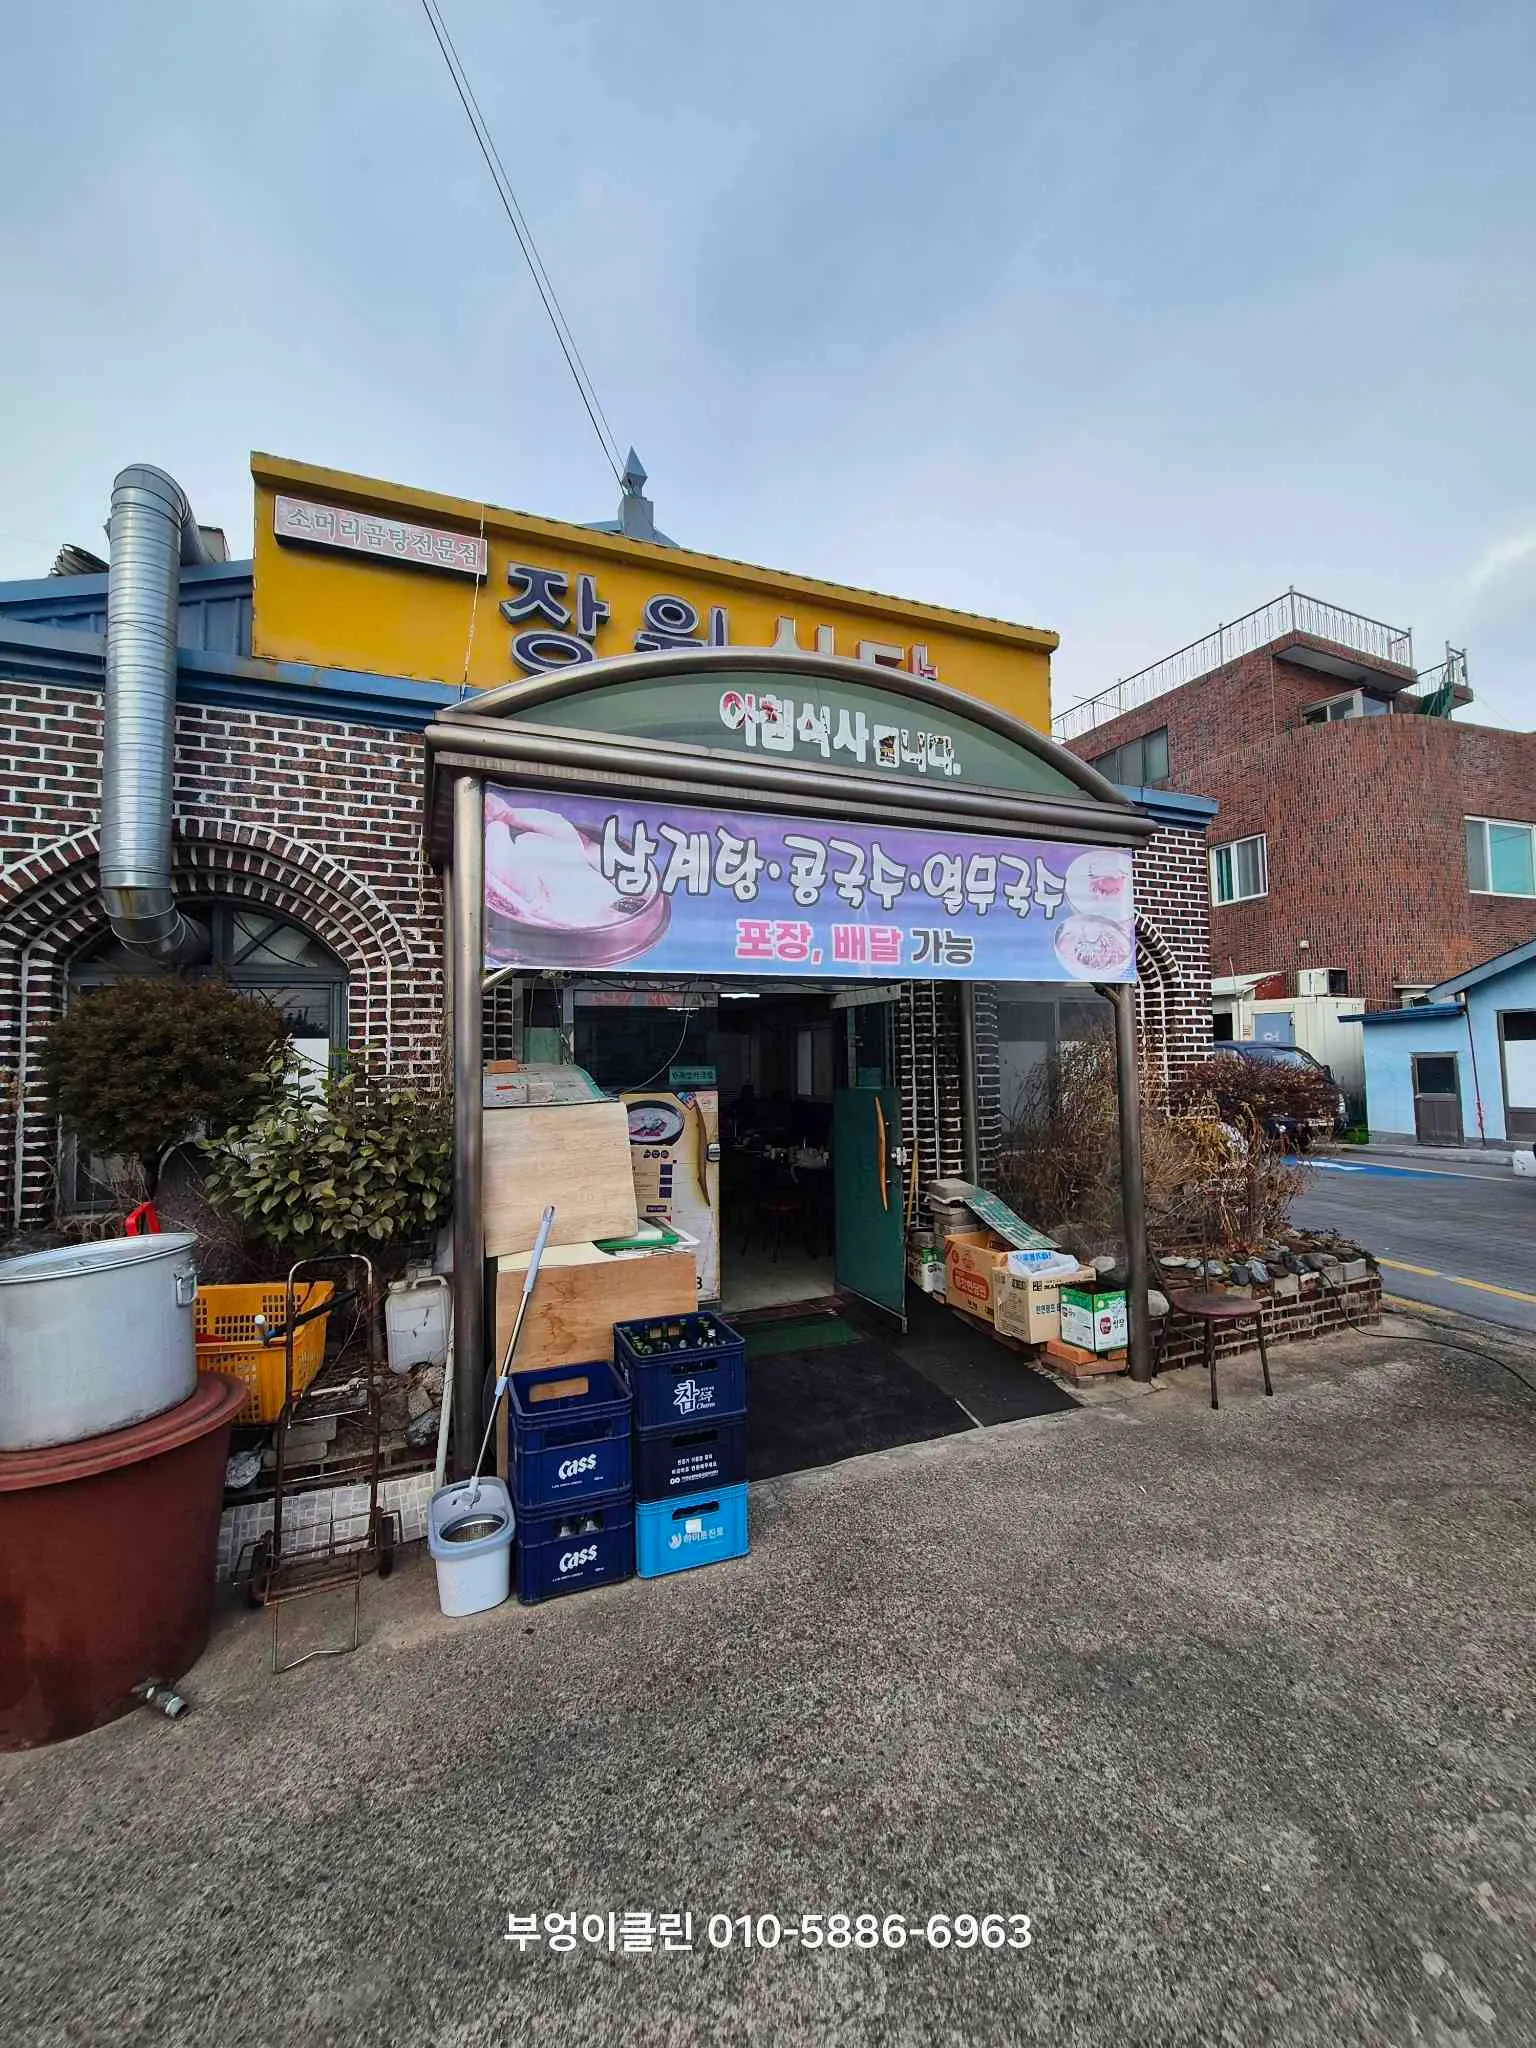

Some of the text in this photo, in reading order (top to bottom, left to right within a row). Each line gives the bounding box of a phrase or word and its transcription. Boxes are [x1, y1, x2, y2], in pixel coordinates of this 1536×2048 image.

[287, 508, 480, 568] 소머리곰탕전문점
[735, 919, 975, 966] 포장, 배달 가능
[673, 1379, 700, 1415] 참
[558, 1453, 597, 1480] Cass
[559, 1544, 598, 1573] Cass
